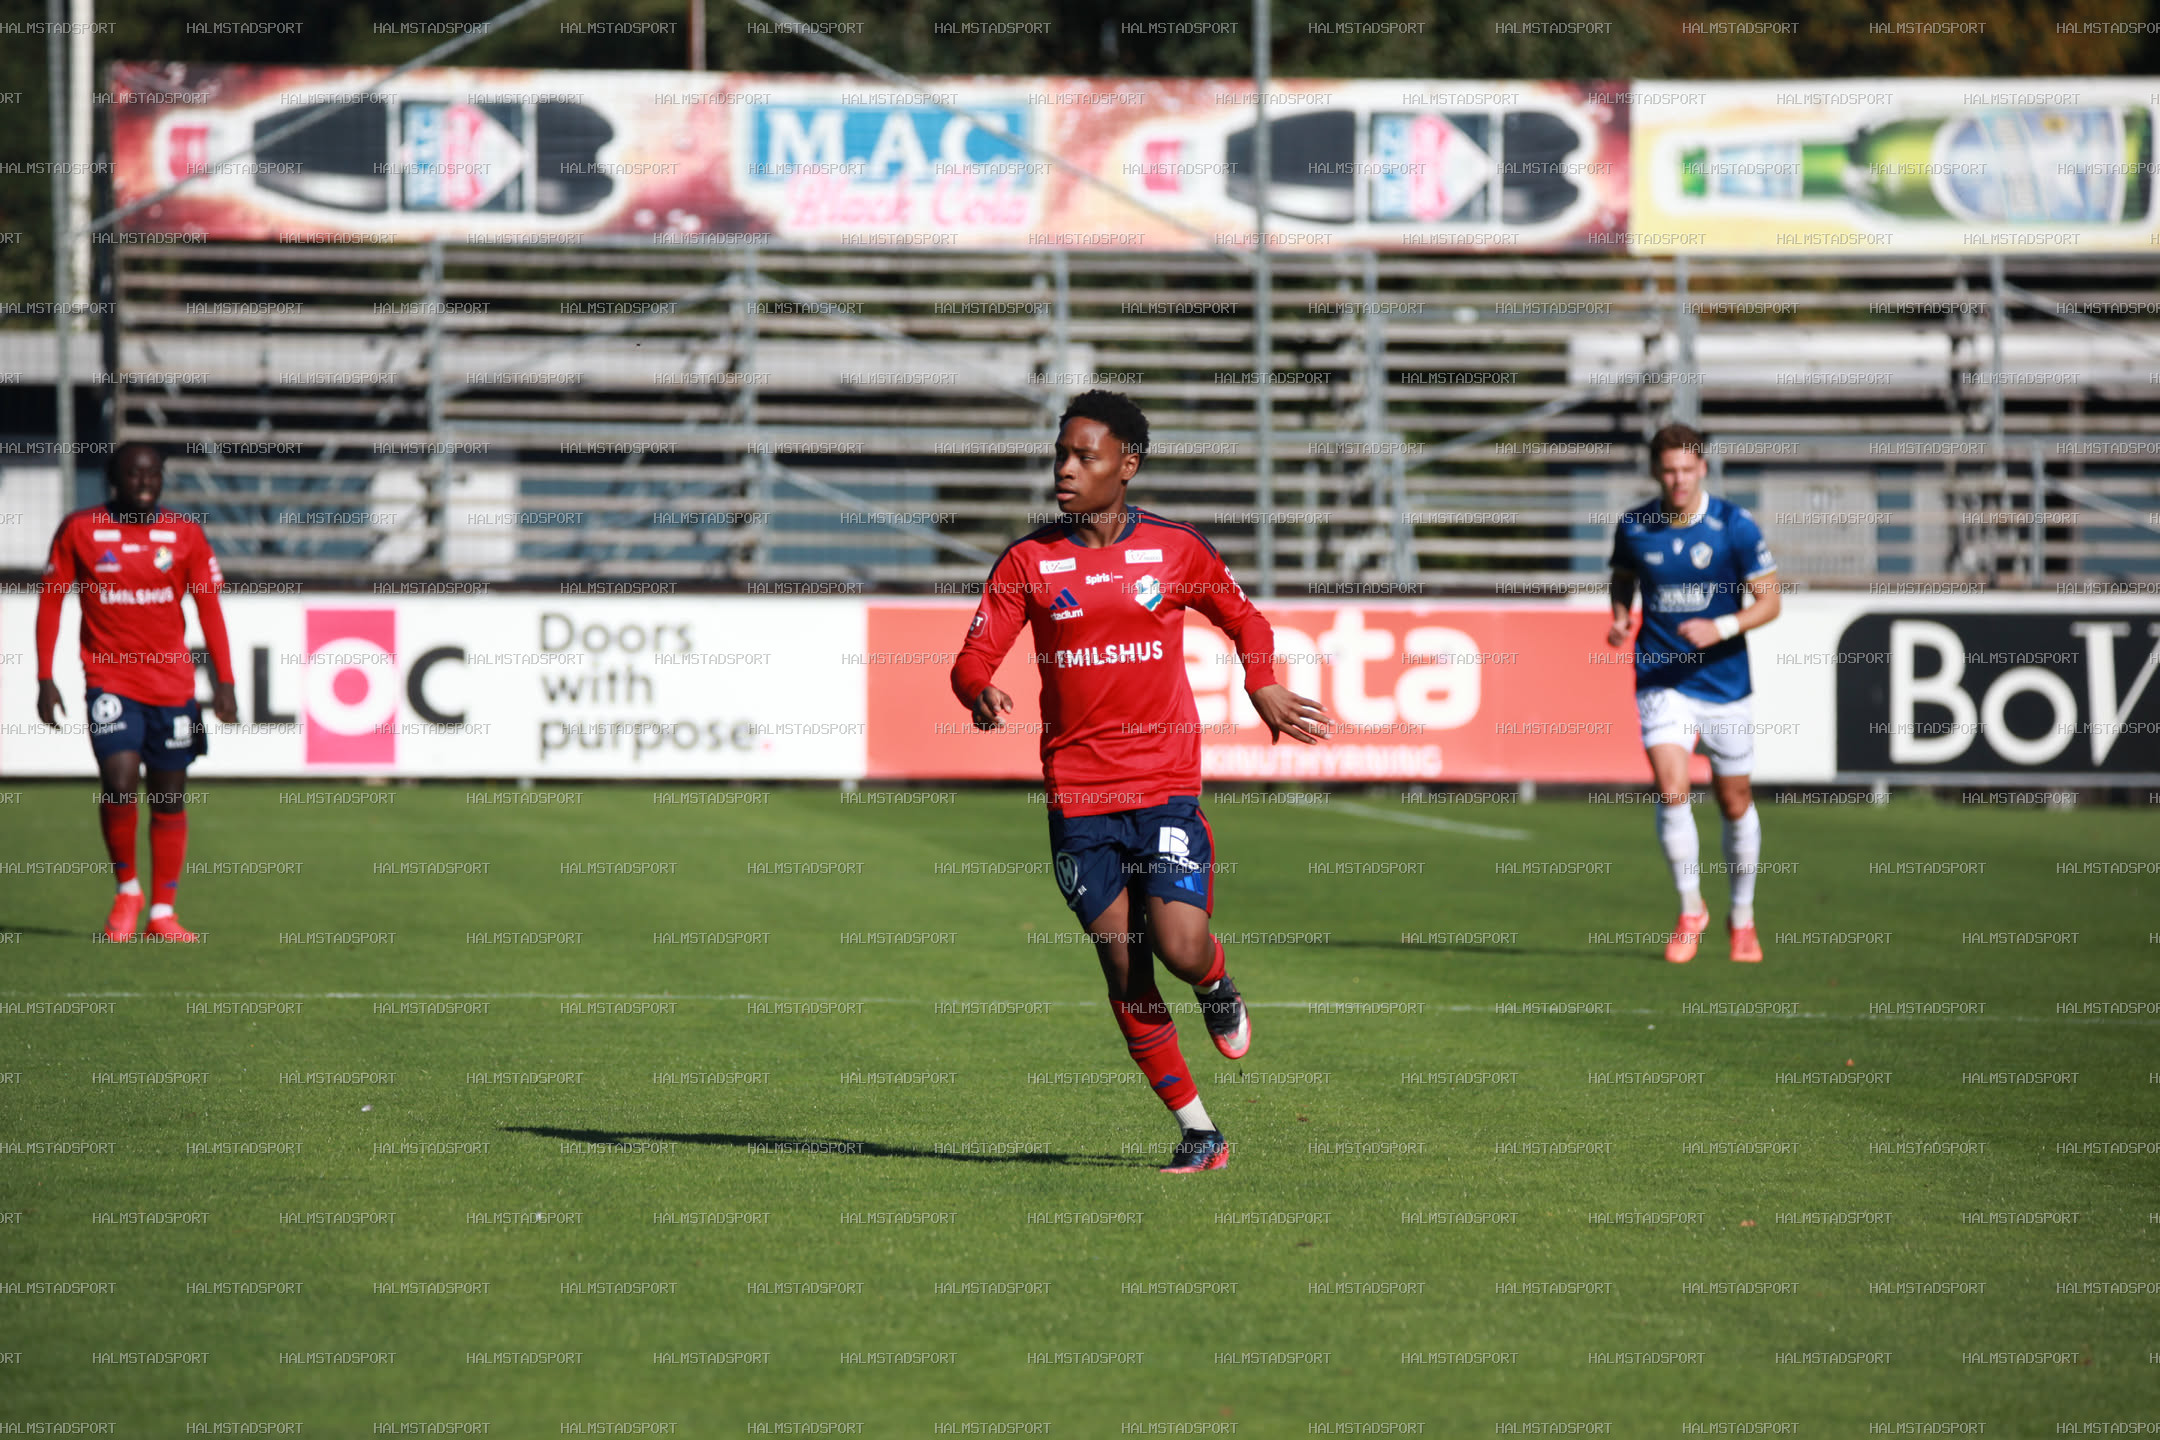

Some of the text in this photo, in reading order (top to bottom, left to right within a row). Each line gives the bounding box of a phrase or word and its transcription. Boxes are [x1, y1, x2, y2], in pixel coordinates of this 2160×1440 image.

[539, 612, 694, 654] Doors
[1057, 640, 1163, 668] EMILSHUS
[541, 661, 654, 704] with
